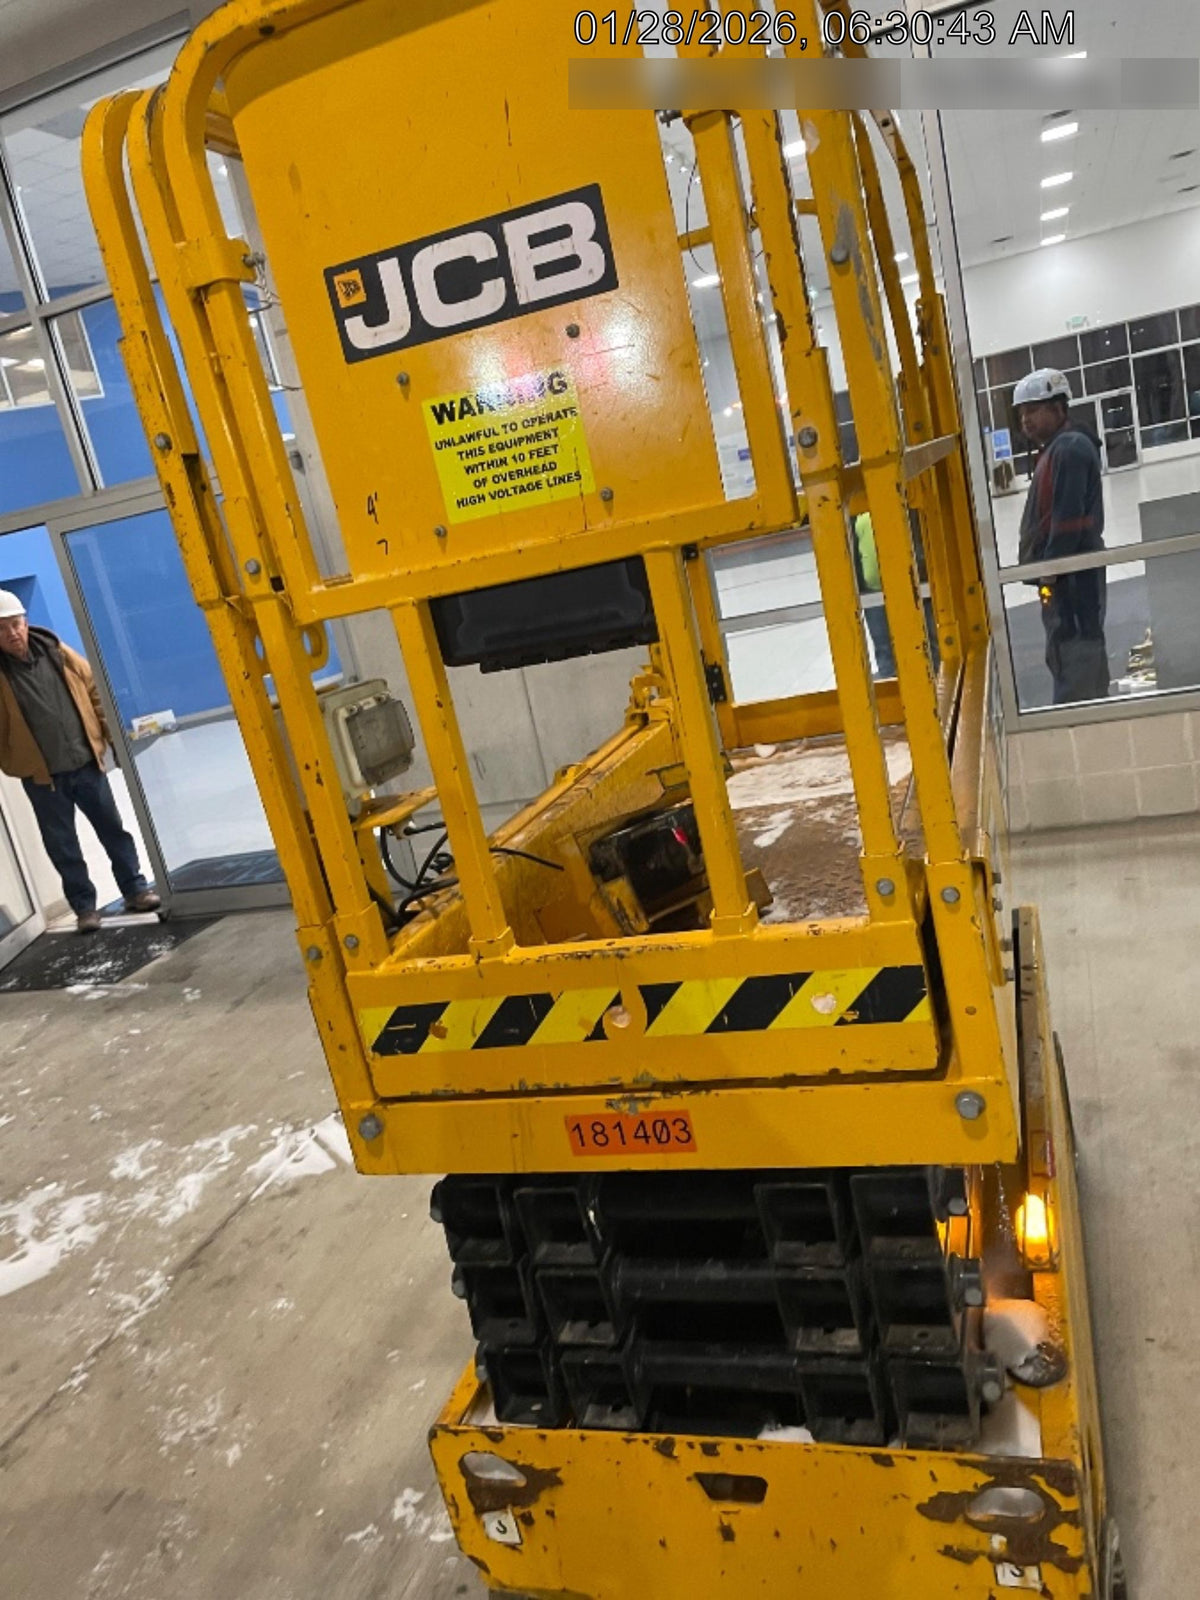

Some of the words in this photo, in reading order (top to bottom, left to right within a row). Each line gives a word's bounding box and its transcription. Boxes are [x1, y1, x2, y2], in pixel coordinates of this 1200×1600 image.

[344, 201, 606, 349] JCB
[430, 371, 568, 425] WARG
[435, 428, 500, 451] UNLAWFUL
[501, 422, 518, 434] TO
[522, 406, 578, 429] OPERATE
[457, 445, 485, 461] THIS
[488, 427, 558, 453] EQUIPMENT
[464, 456, 508, 475] WITHIN
[512, 452, 526, 464] 10
[529, 444, 559, 460] FEET
[473, 476, 488, 489] OF
[491, 461, 557, 485] OVERHEAD
[456, 493, 486, 509] HIGH
[488, 480, 543, 501] VOLTAGE
[547, 470, 582, 487] LINES
[571, 1117, 693, 1148] 181403
